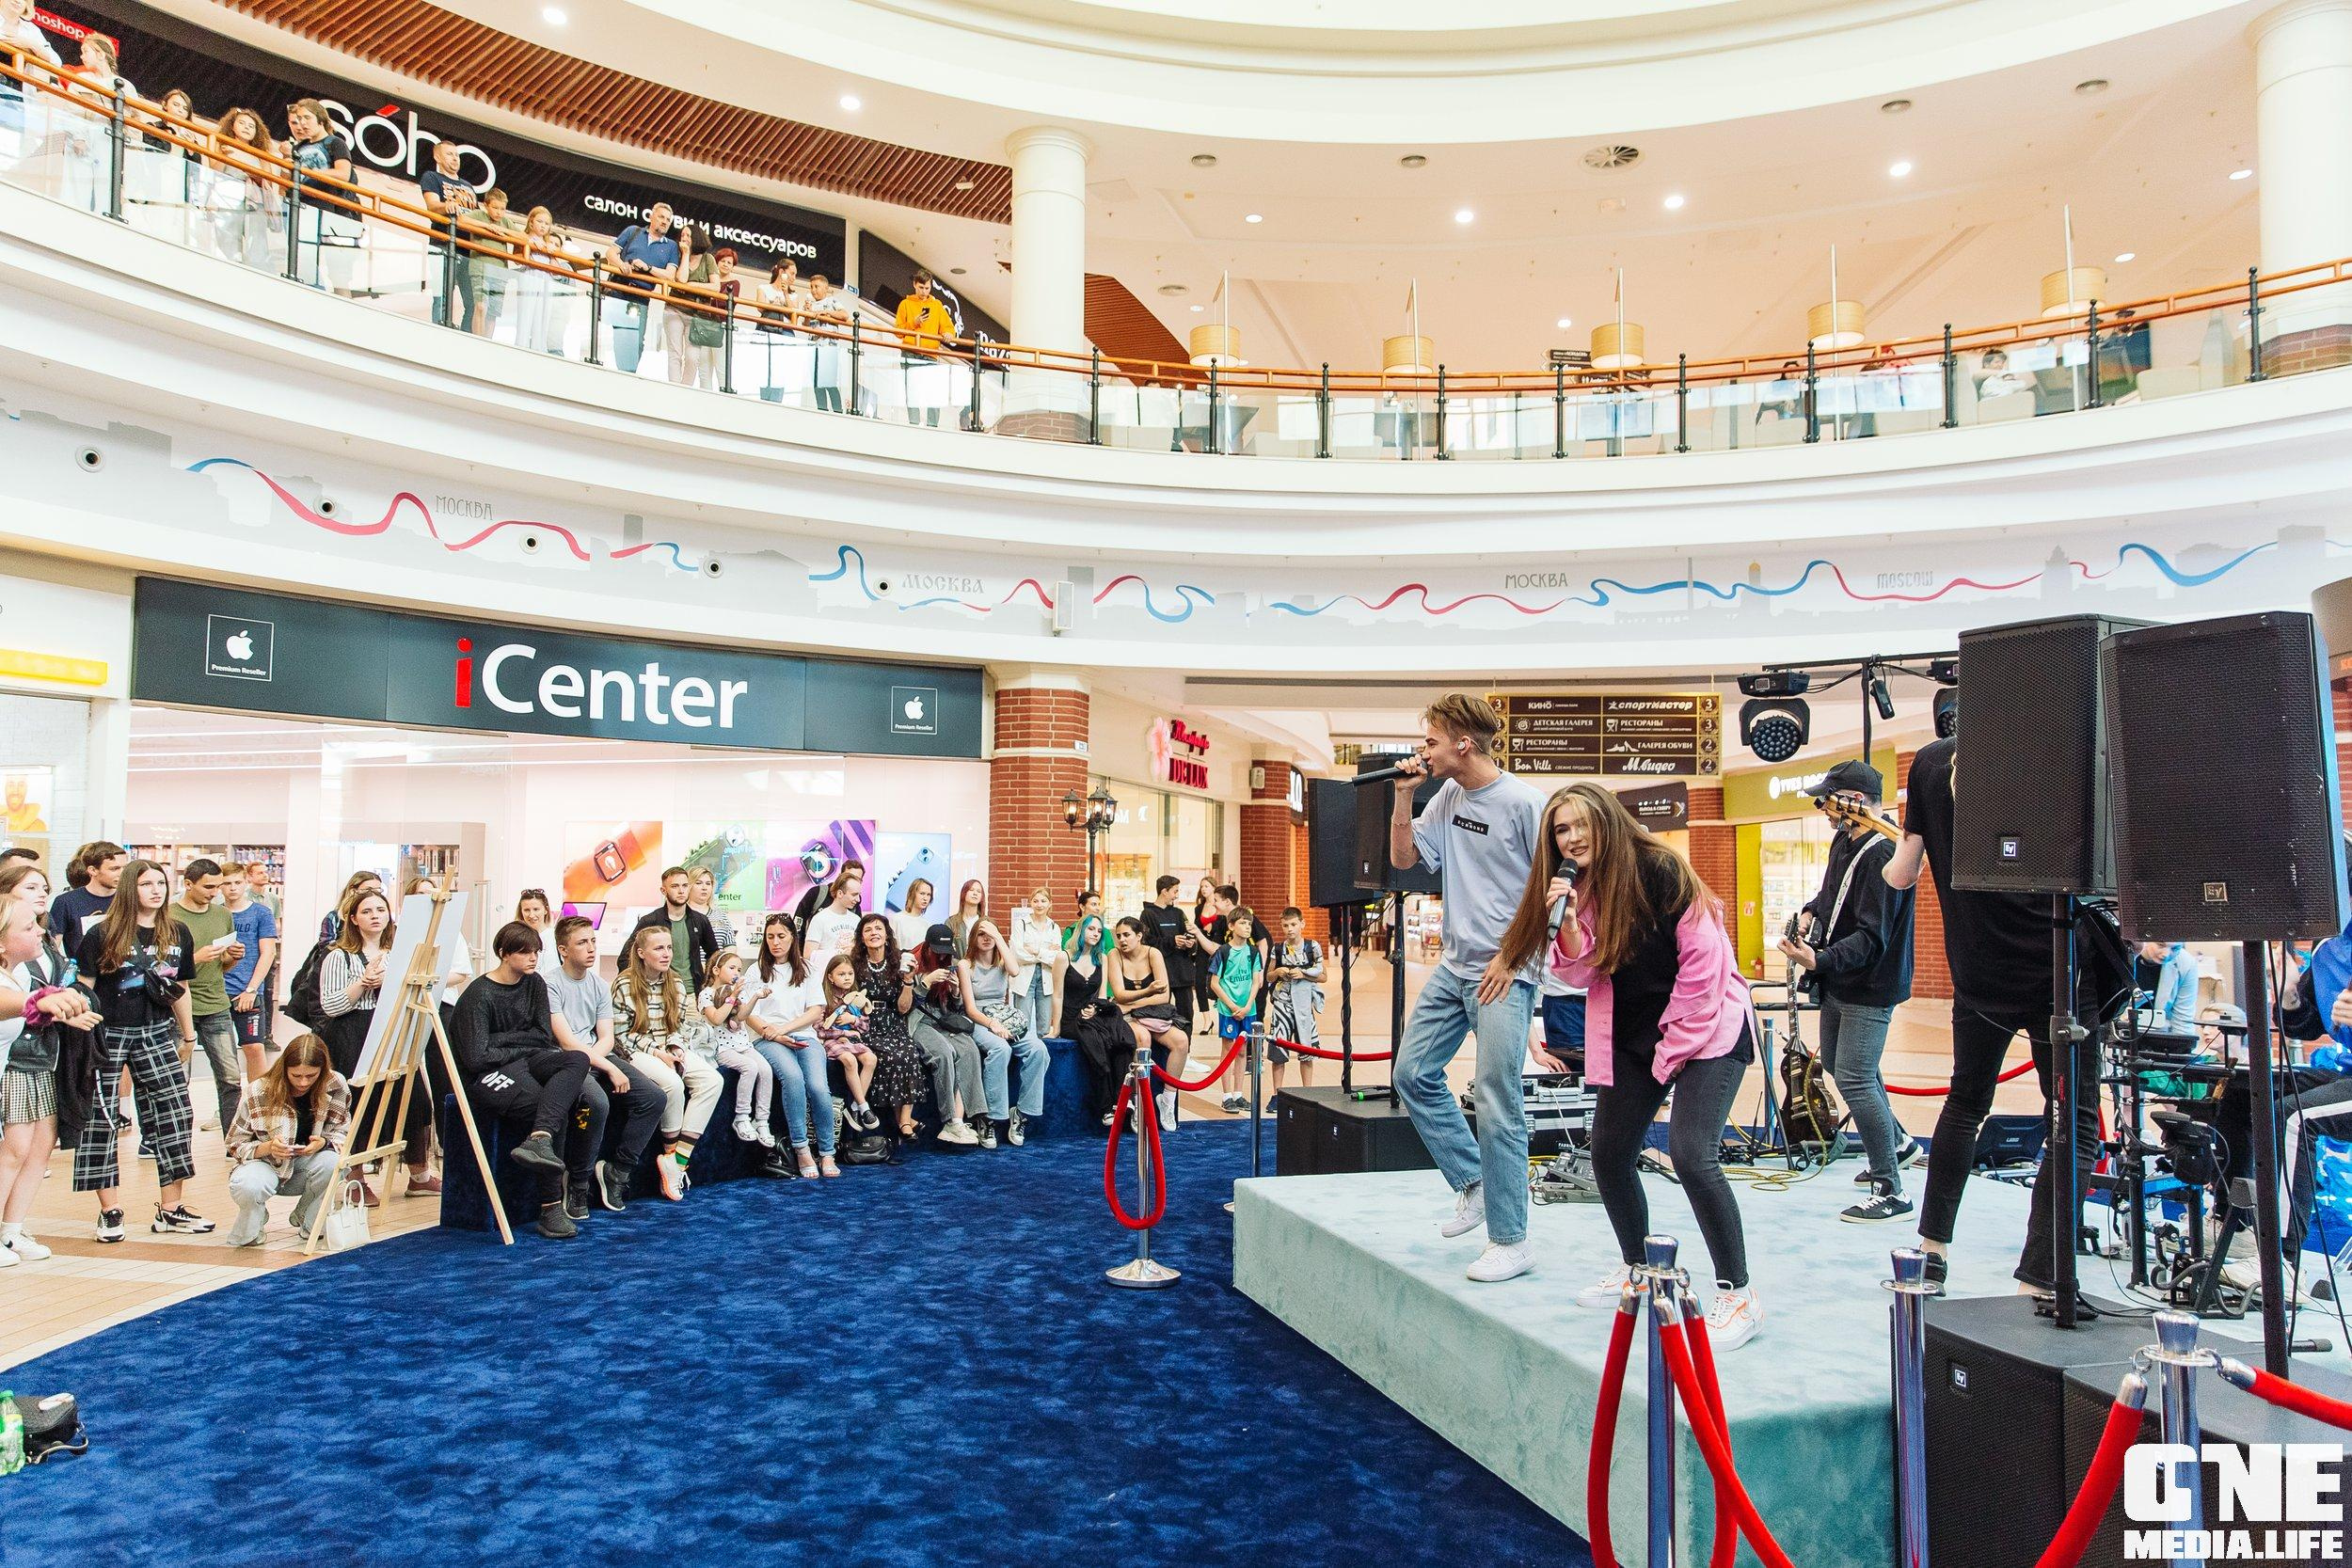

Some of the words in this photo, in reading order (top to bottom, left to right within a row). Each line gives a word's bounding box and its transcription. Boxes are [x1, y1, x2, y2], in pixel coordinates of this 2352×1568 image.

[583, 194, 638, 219] салон
[713, 223, 817, 259] аксессуаров
[436, 495, 493, 520] МОСКВА
[902, 574, 984, 594] МОСКВА
[1504, 572, 1568, 589] МОСКВА
[212, 663, 241, 673] Premium
[241, 667, 267, 676] Reseller
[454, 637, 748, 729] iCenter
[1494, 699, 1502, 709] 3
[1705, 699, 1713, 709] 3
[1705, 719, 1712, 729] 3
[1494, 738, 1502, 749] 2
[1705, 739, 1713, 749] 2
[1515, 758, 1532, 770] Bon
[1534, 758, 1551, 770] Ville
[1705, 759, 1713, 769] 2
[481, 1070, 516, 1091] OFF
